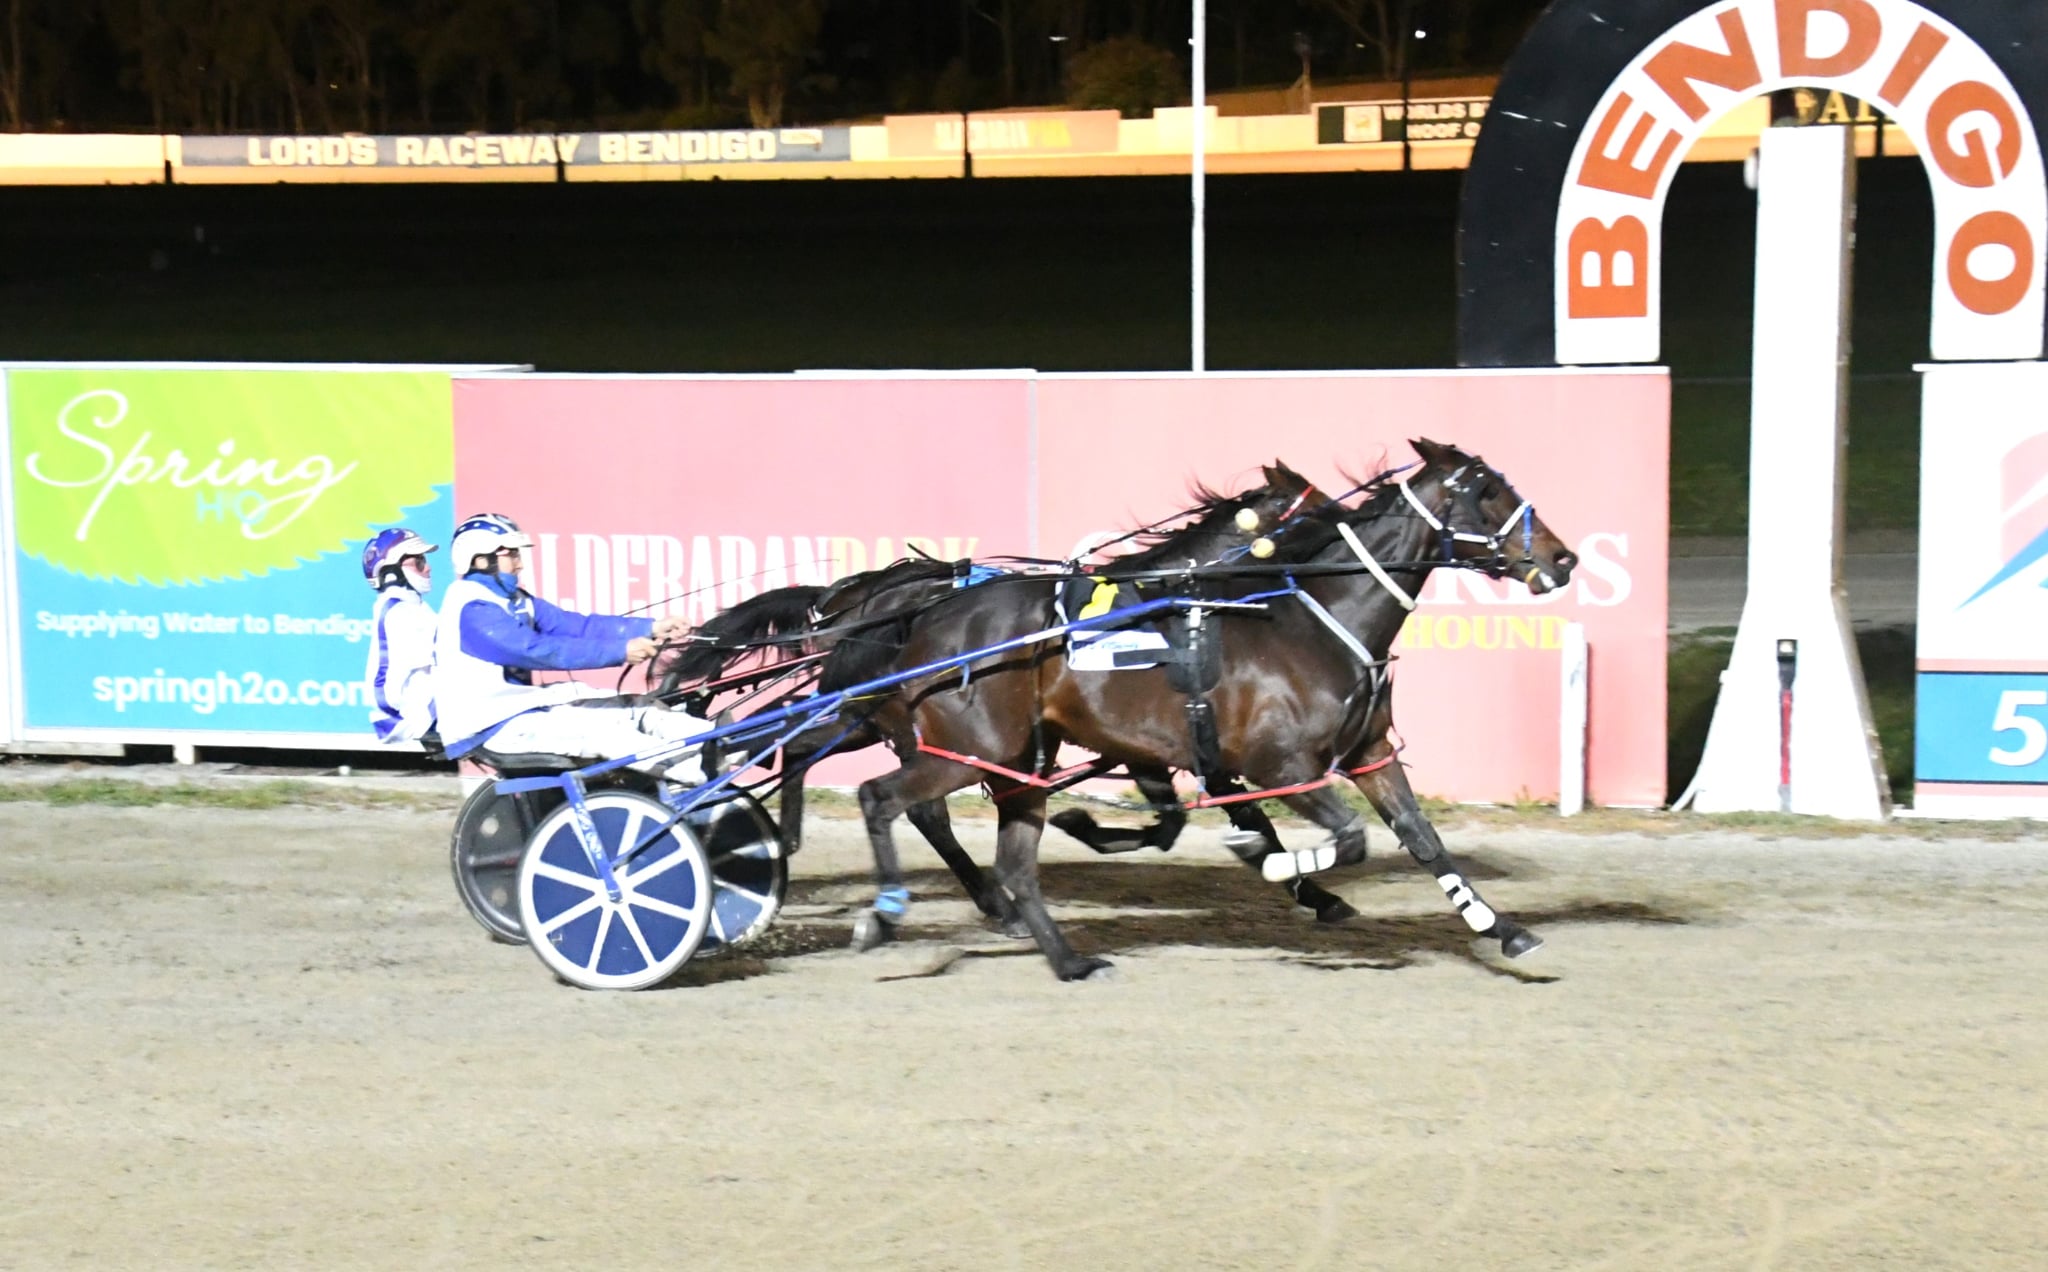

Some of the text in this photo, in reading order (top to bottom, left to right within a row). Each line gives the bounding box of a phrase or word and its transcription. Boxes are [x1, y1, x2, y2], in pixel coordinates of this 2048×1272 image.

[247, 135, 378, 166] LORD'S
[396, 135, 580, 165] RACEWAY
[599, 130, 776, 163] BENDIGO
[1569, 0, 2035, 319] BENDIGO
[25, 388, 360, 542] Spring
[36, 610, 159, 640] Supplying
[163, 612, 240, 634] Water
[243, 614, 270, 635] to
